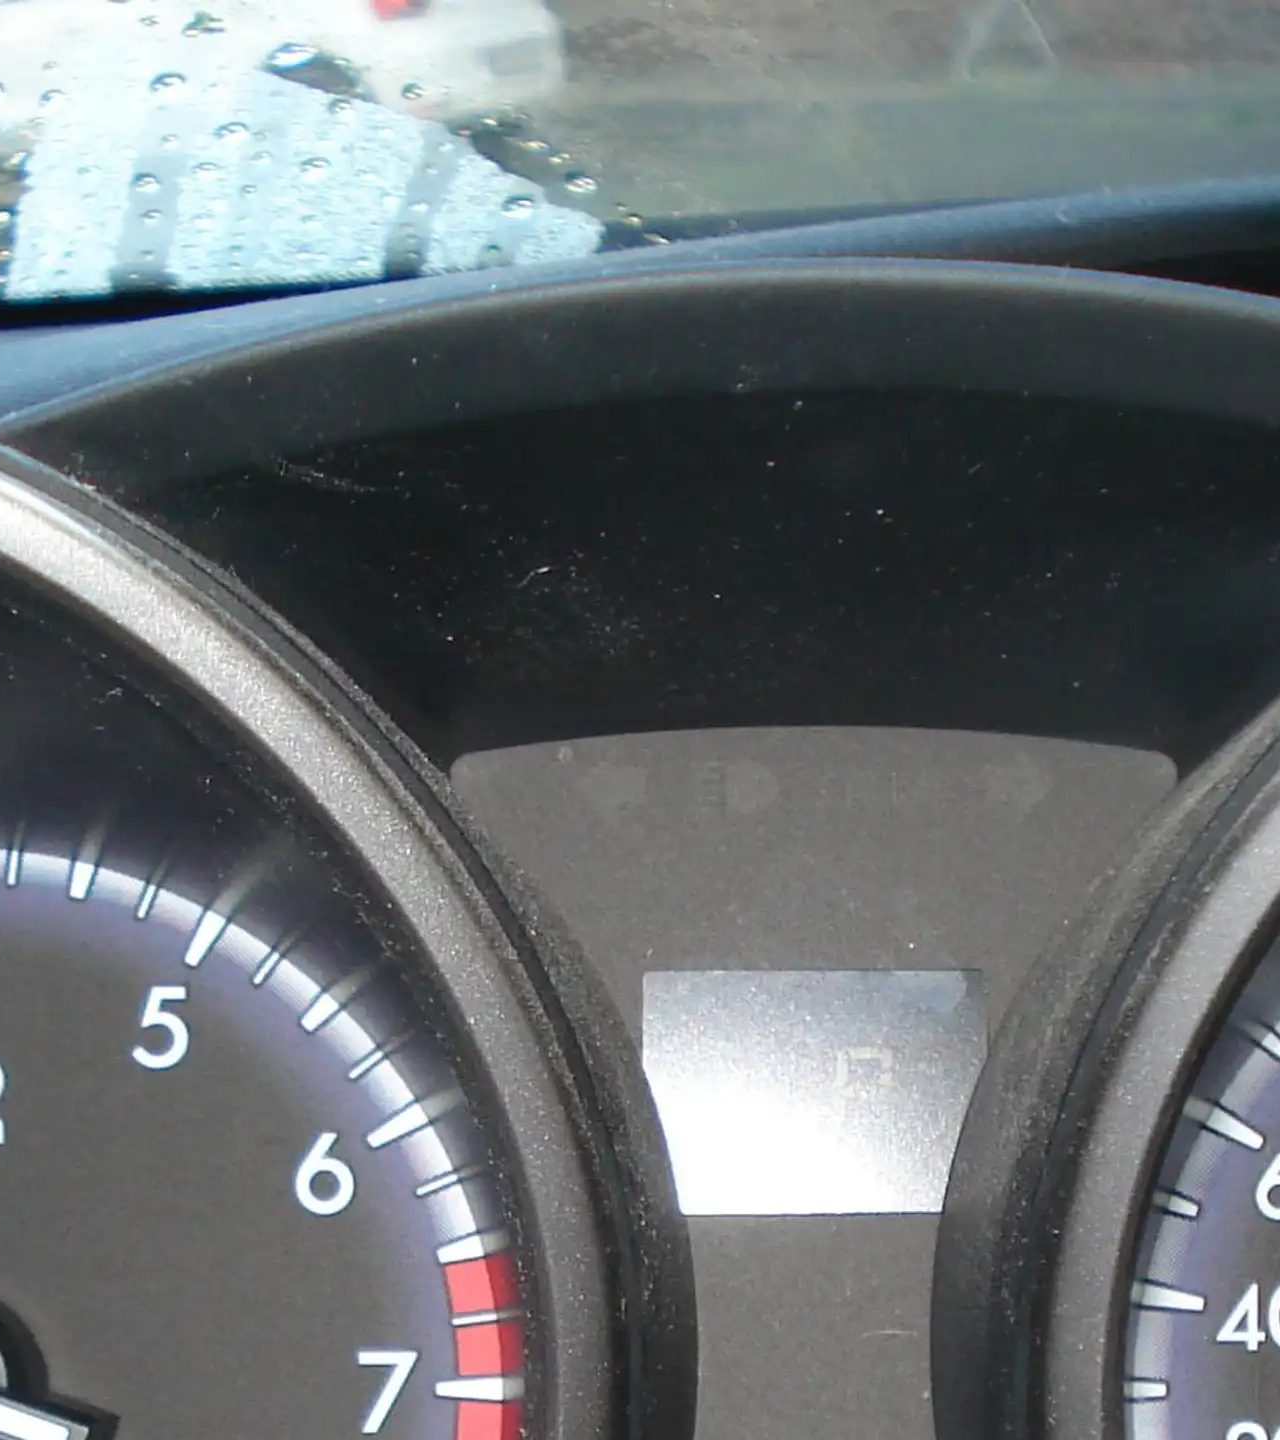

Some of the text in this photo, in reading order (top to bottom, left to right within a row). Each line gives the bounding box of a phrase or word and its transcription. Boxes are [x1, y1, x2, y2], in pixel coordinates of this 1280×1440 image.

[132, 985, 189, 1069] 5
[295, 1132, 354, 1215] 6
[357, 1350, 418, 1434] 7
